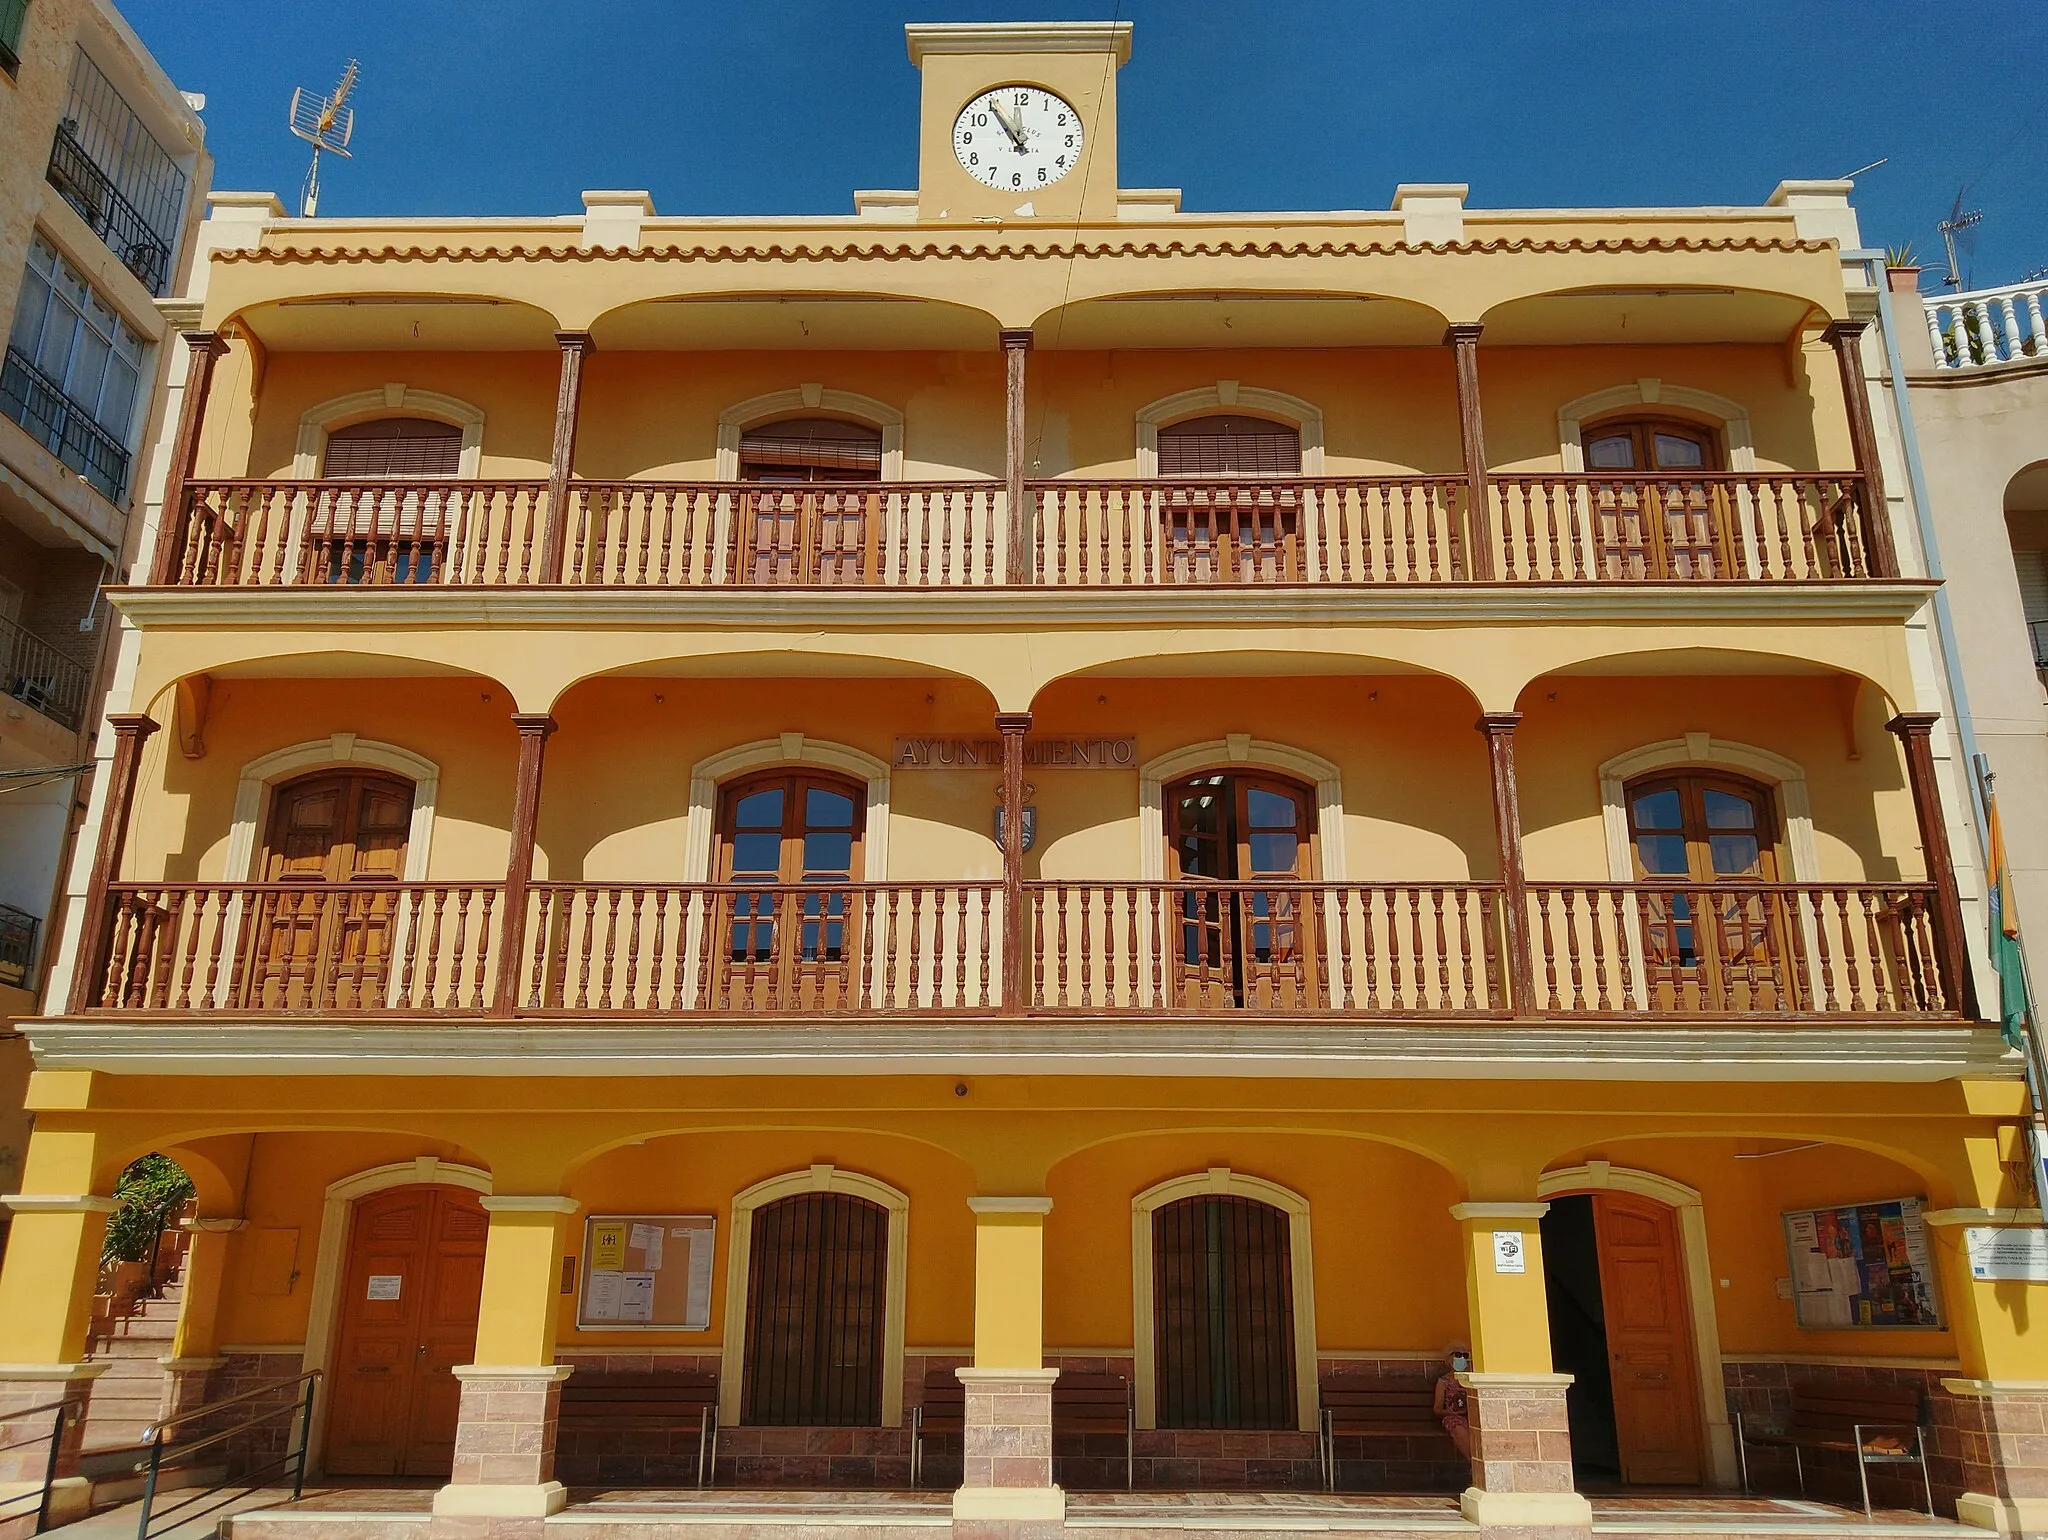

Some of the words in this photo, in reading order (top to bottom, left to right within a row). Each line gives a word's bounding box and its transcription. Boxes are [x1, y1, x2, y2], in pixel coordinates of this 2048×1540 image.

[1014, 93, 1029, 106] 12
[1043, 99, 1049, 111] 1
[971, 113, 988, 127] 10
[1057, 113, 1066, 126] 2
[963, 132, 973, 144] 9
[1065, 135, 1074, 147] 3
[970, 152, 979, 165] 8
[1055, 154, 1065, 168] 4
[988, 167, 998, 180] 7
[1012, 173, 1021, 186] 6
[1037, 167, 1047, 181] 5
